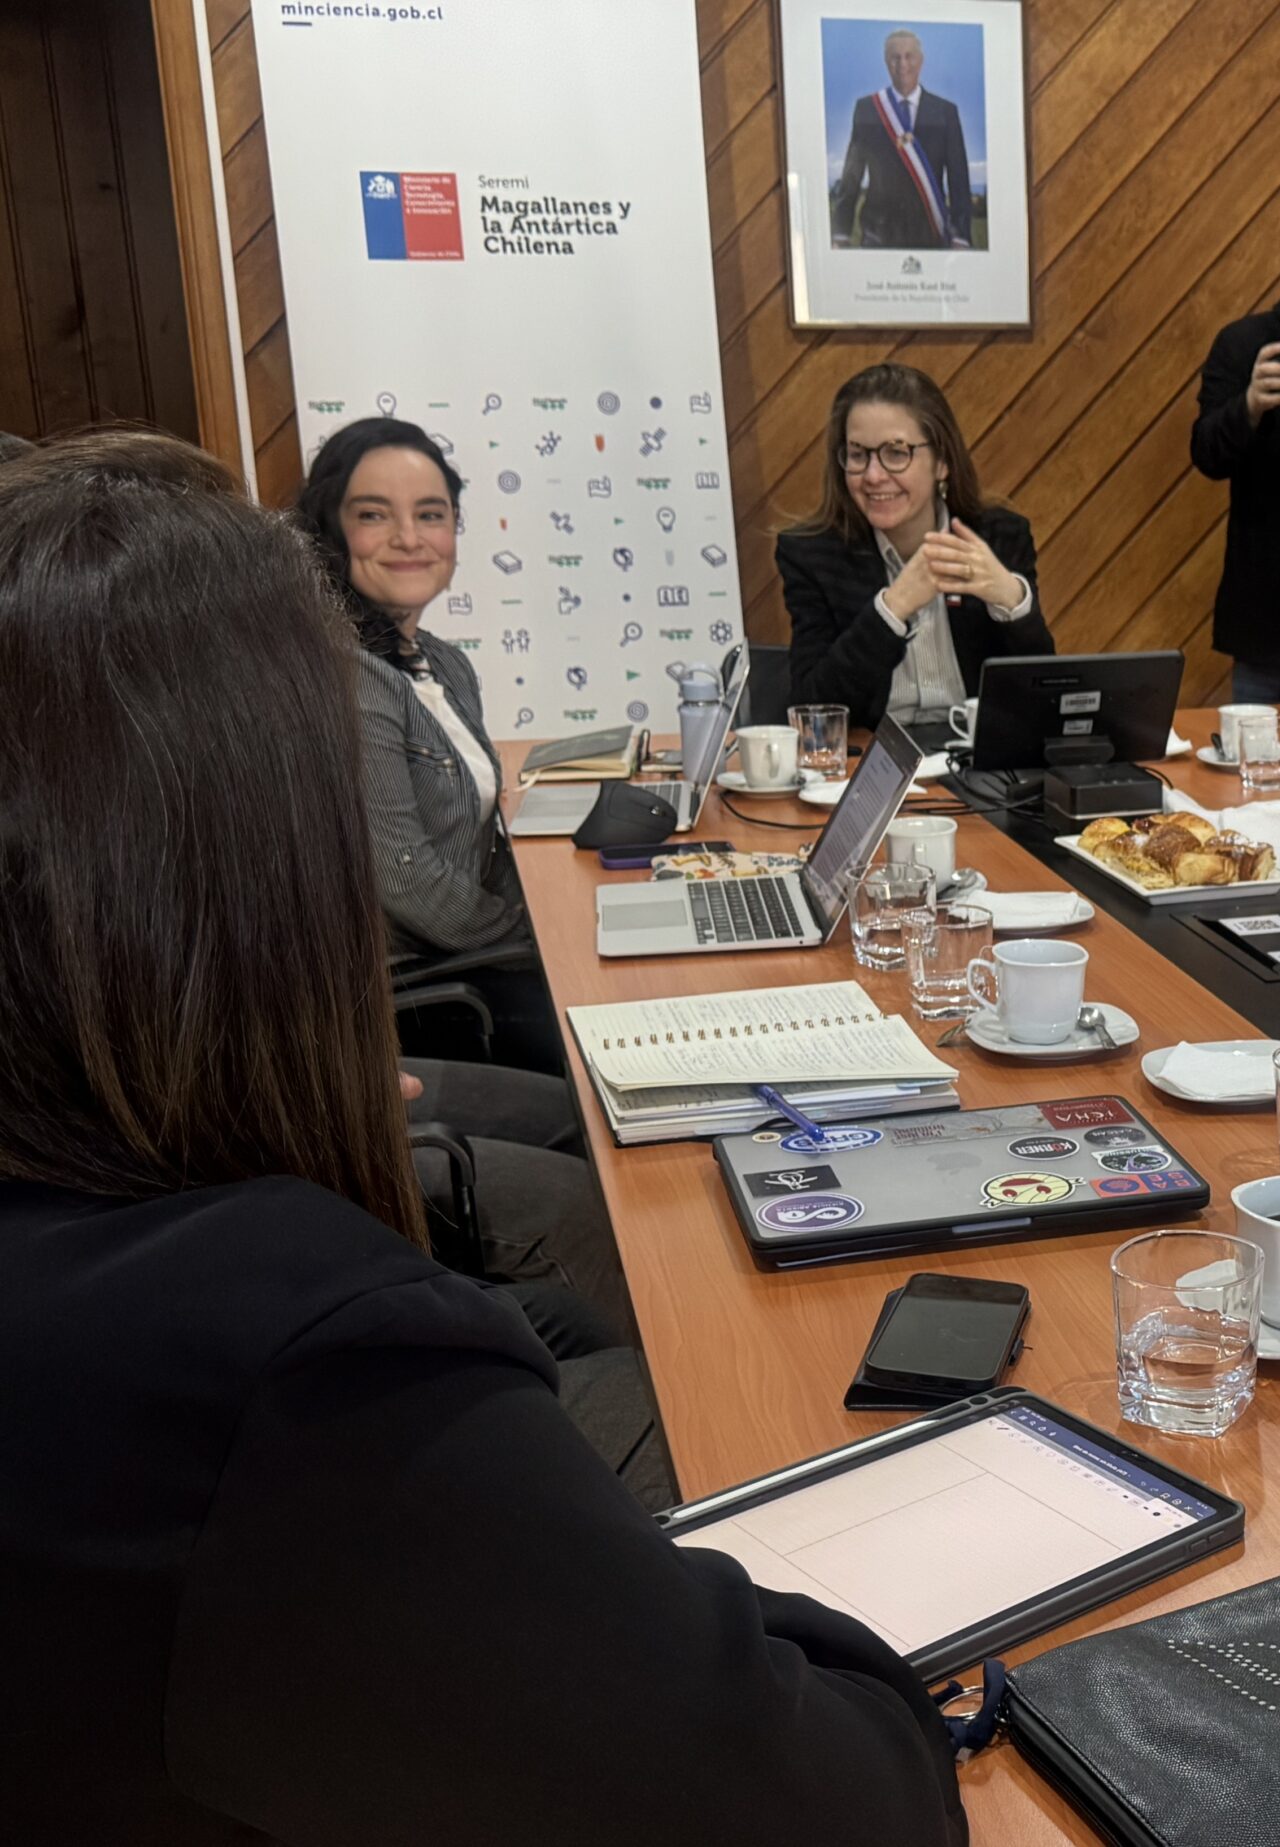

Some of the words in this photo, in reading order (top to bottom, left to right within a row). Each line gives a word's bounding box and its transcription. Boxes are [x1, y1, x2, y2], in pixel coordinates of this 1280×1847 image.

[281, 1, 443, 21] minciencia.gob.cl
[478, 174, 529, 189] Seremi
[480, 195, 613, 218] Magallanes
[618, 201, 631, 219] y
[481, 215, 503, 234] la
[510, 215, 618, 235] Antártica
[483, 236, 575, 255] Chilena
